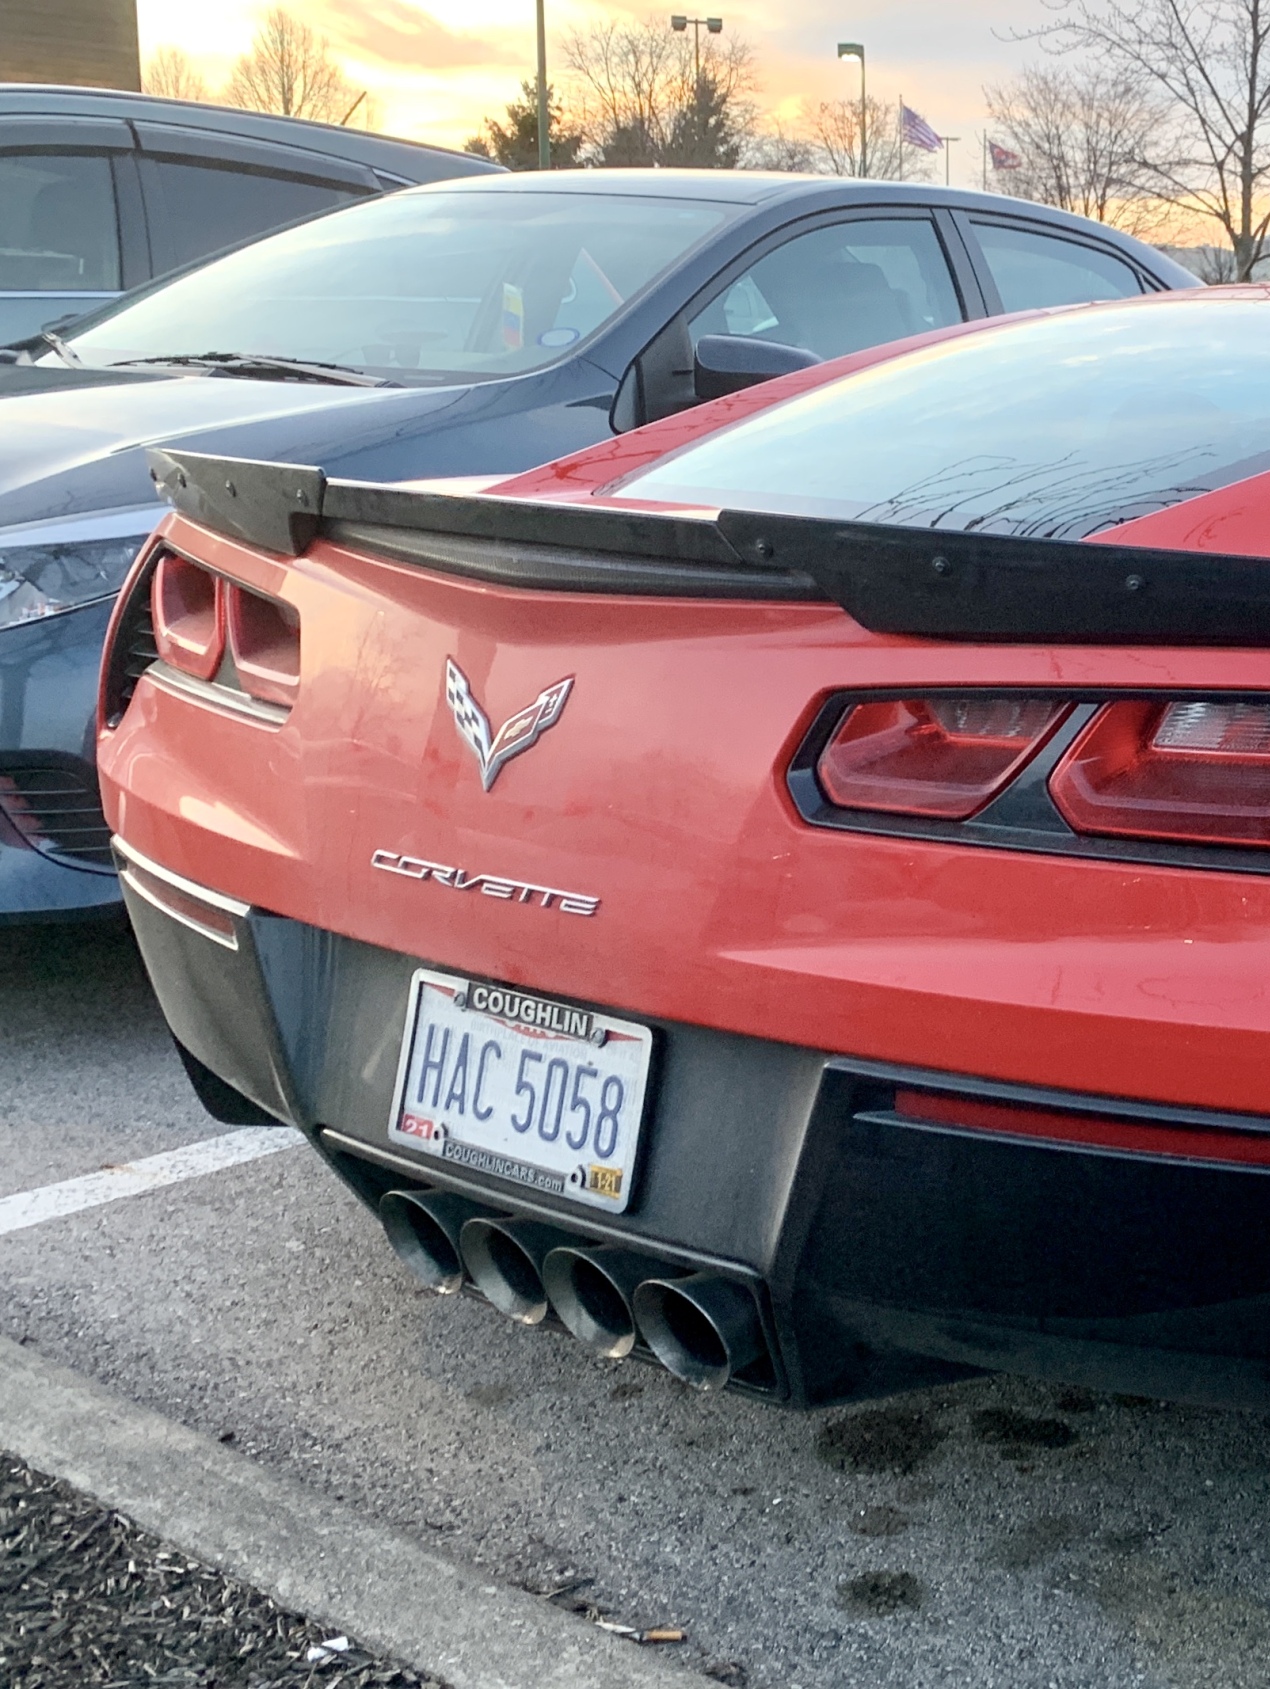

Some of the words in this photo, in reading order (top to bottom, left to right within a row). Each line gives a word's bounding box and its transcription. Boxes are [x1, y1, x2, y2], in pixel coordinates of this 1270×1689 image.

[371, 849, 600, 916] CORVETTE
[472, 986, 589, 1039] COUGHLIN
[416, 1023, 502, 1121] HAC
[510, 1048, 626, 1160] 5058
[404, 1120, 429, 1138] 21
[444, 1142, 563, 1192] COUGHLINCARS.com
